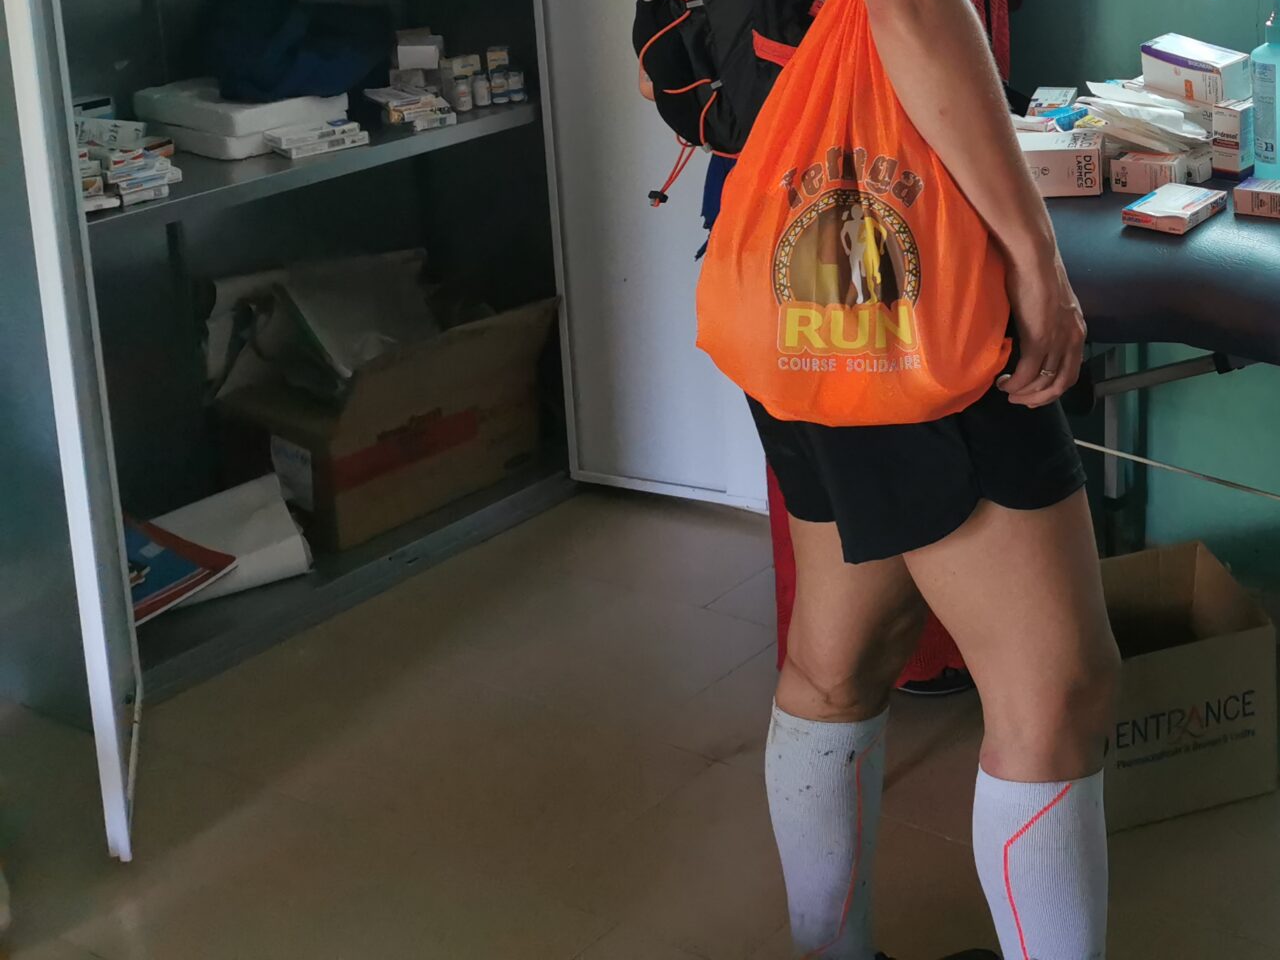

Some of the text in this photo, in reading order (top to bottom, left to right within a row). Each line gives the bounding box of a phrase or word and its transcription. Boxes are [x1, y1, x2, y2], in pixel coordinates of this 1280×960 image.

[1075, 155, 1084, 189] LARMES
[1084, 155, 1094, 189] DULCI
[784, 307, 914, 350] RUN
[777, 353, 922, 374] COURSE SOLIDAIRE
[1116, 690, 1256, 749] ENTRANCE
